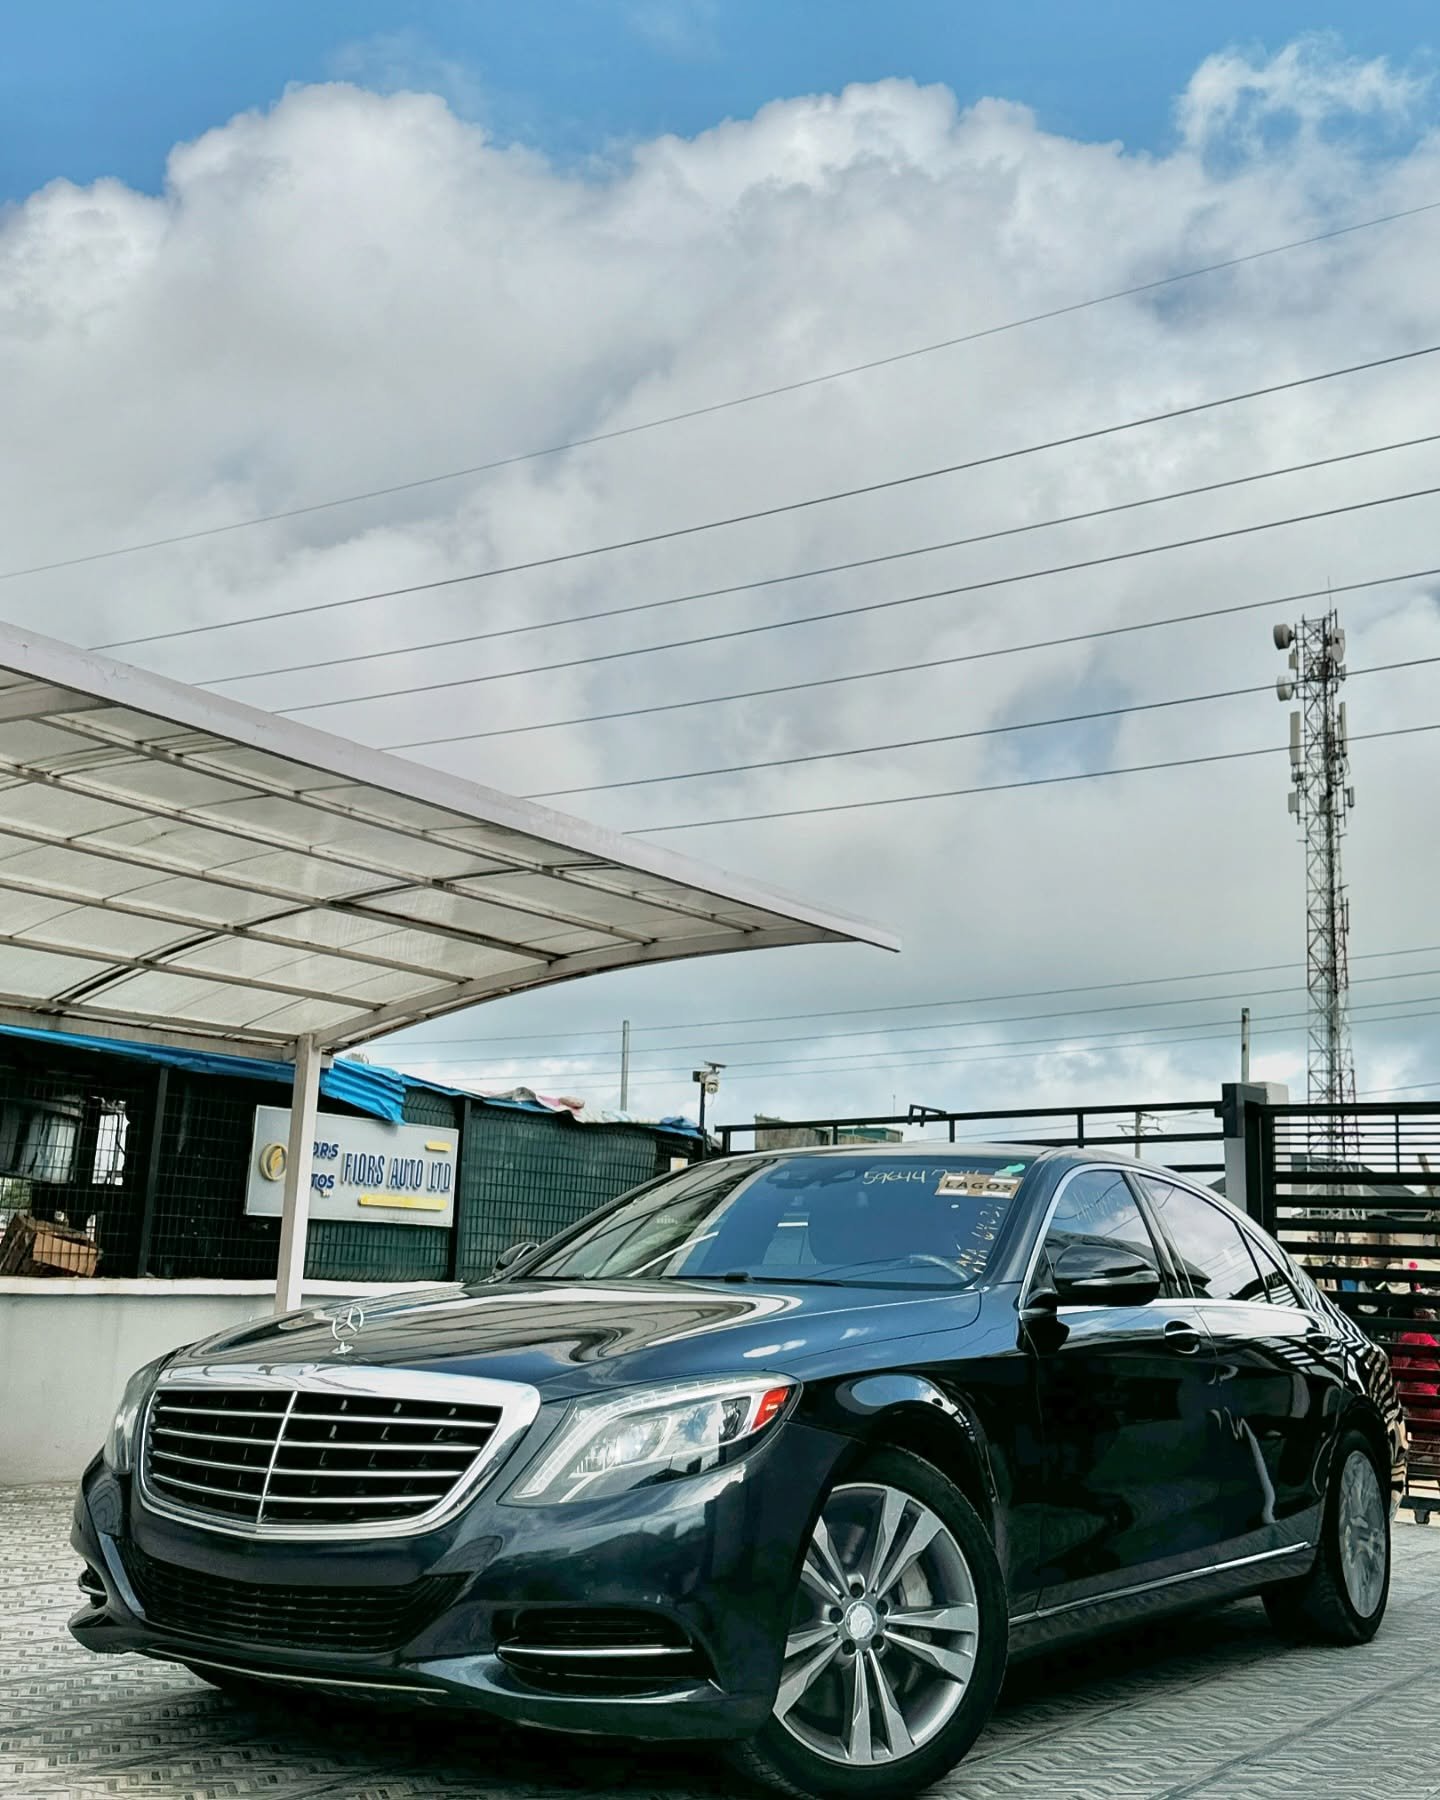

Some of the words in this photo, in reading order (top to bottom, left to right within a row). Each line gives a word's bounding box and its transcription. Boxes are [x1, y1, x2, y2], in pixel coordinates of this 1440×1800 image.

[343, 1152, 385, 1185] FIORS
[390, 1157, 424, 1188] AUTO
[430, 1161, 452, 1190] LTD
[945, 1181, 1013, 1192] LAGOS
